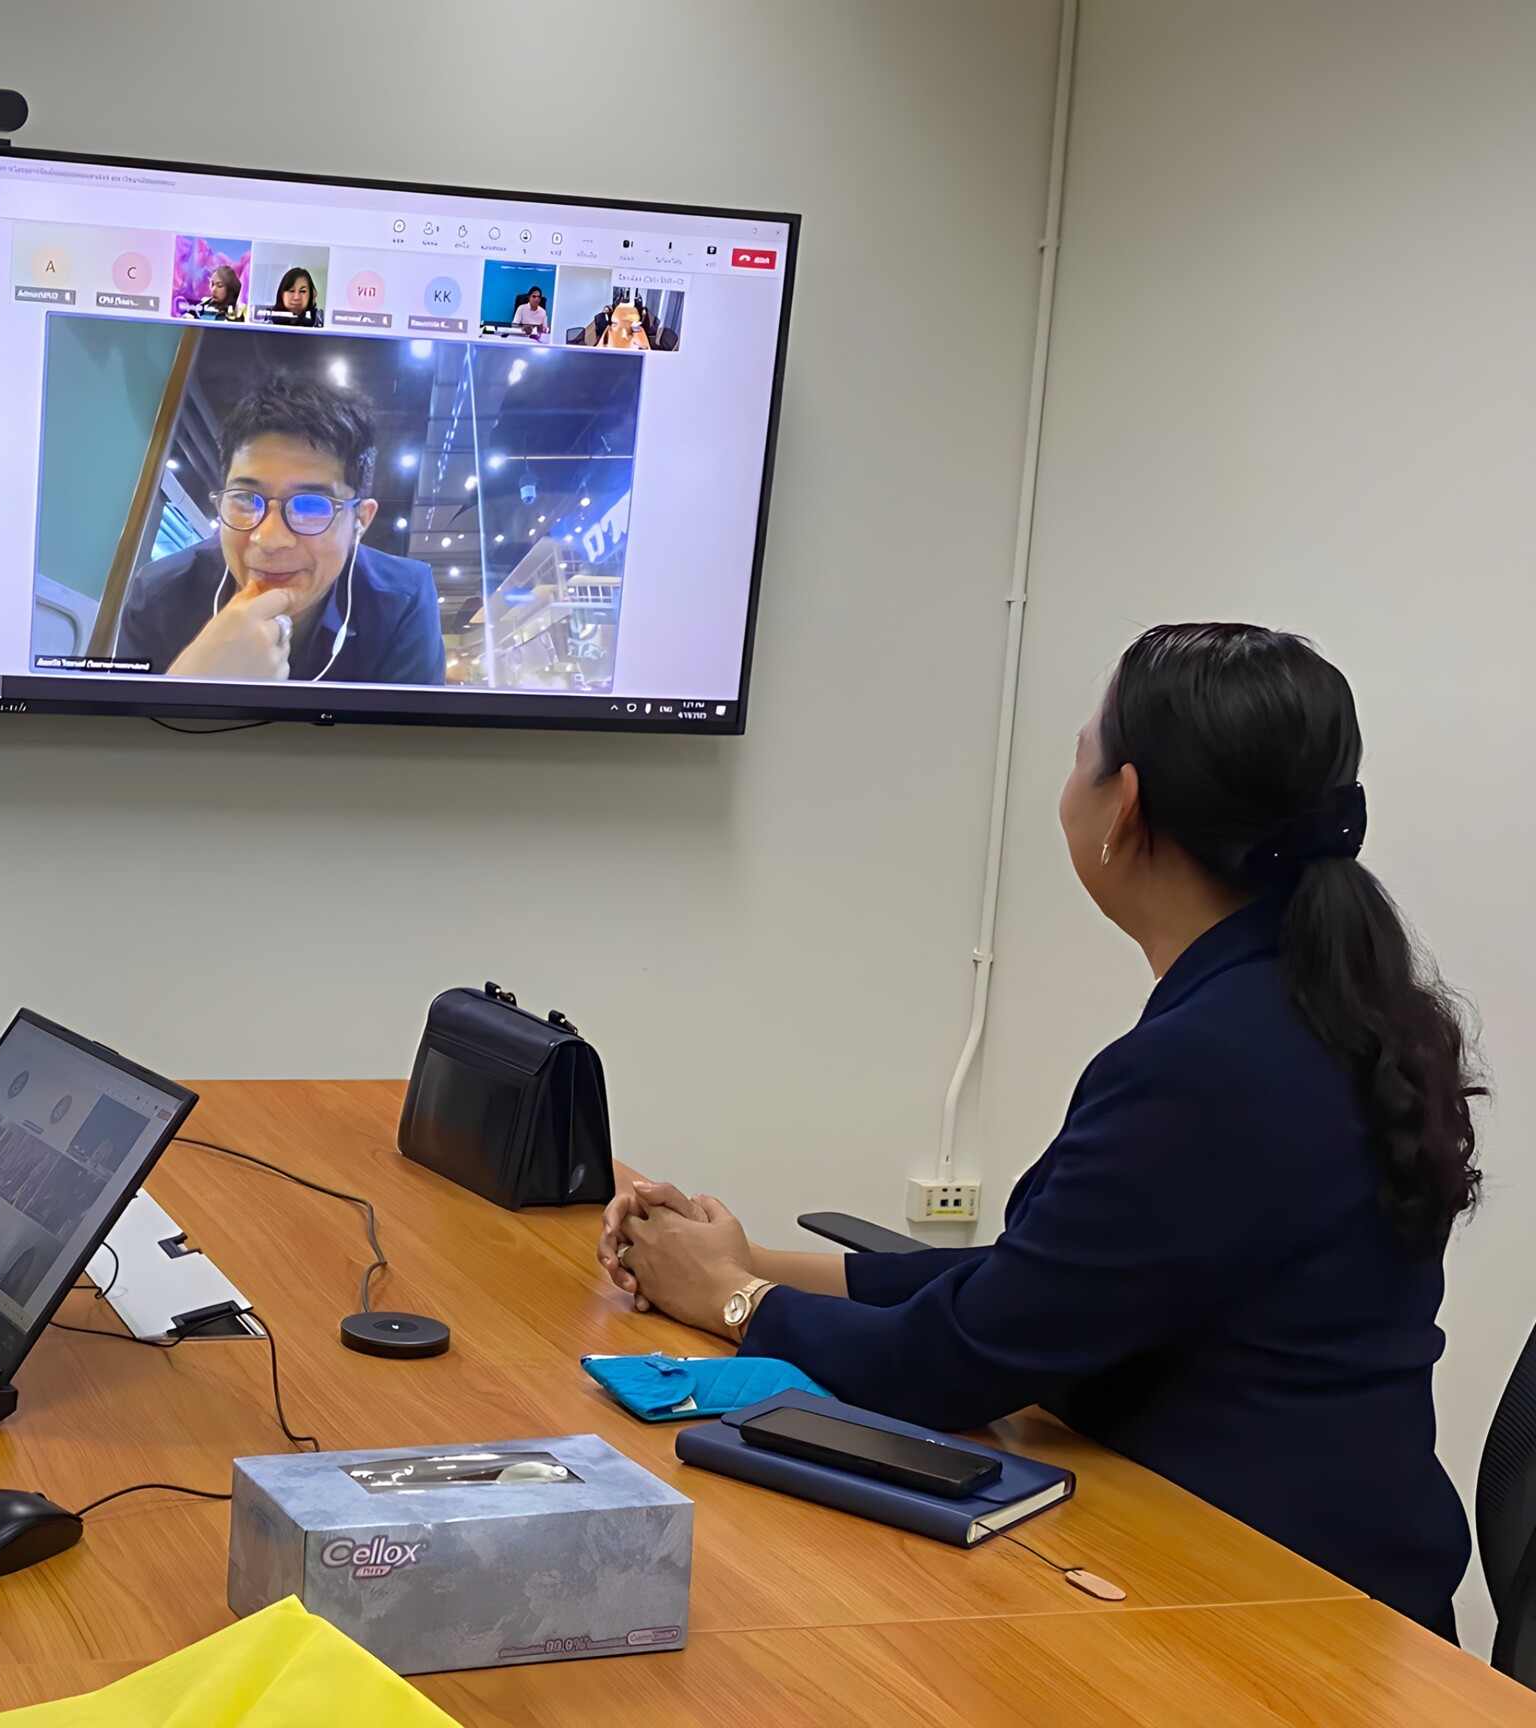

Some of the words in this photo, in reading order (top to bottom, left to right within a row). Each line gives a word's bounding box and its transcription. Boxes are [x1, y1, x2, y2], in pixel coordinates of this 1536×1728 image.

[45, 260, 56, 274] A
[126, 266, 137, 280] C
[434, 290, 452, 303] KK
[322, 1535, 420, 1566] Cellox
